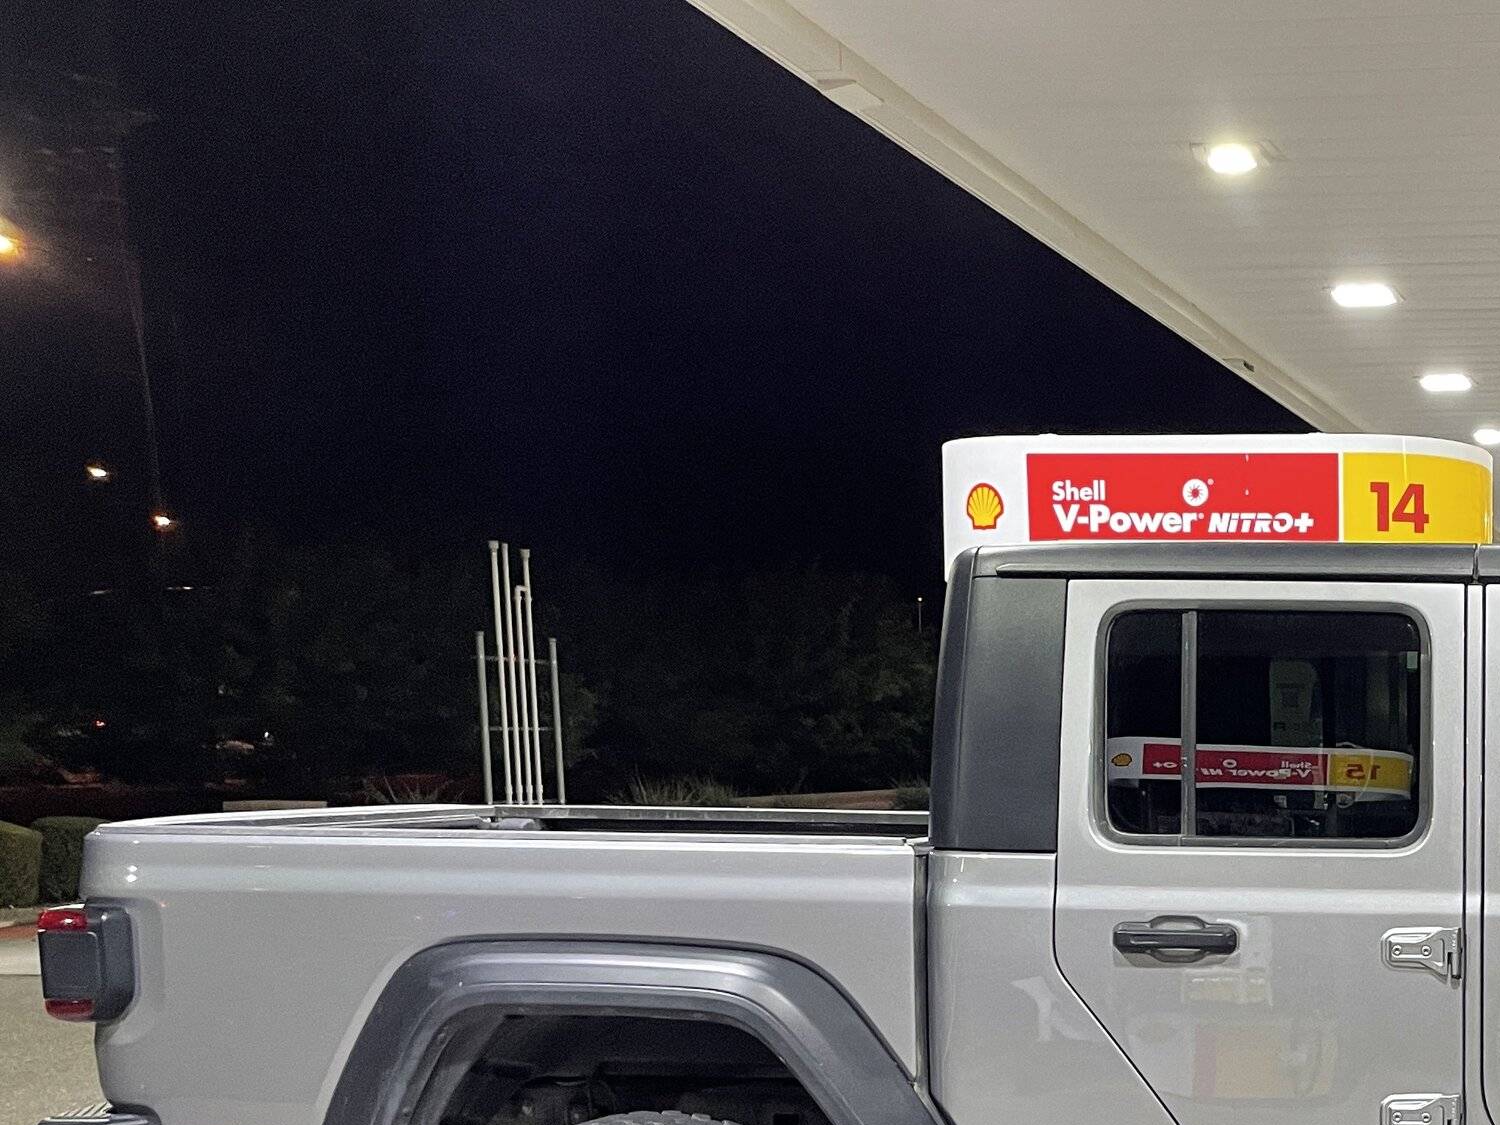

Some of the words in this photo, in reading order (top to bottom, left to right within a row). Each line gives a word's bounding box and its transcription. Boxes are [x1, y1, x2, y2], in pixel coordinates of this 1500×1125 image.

[1052, 480, 1106, 501] Shell
[1052, 503, 1197, 533] V-Power
[1370, 482, 1430, 534] 14
